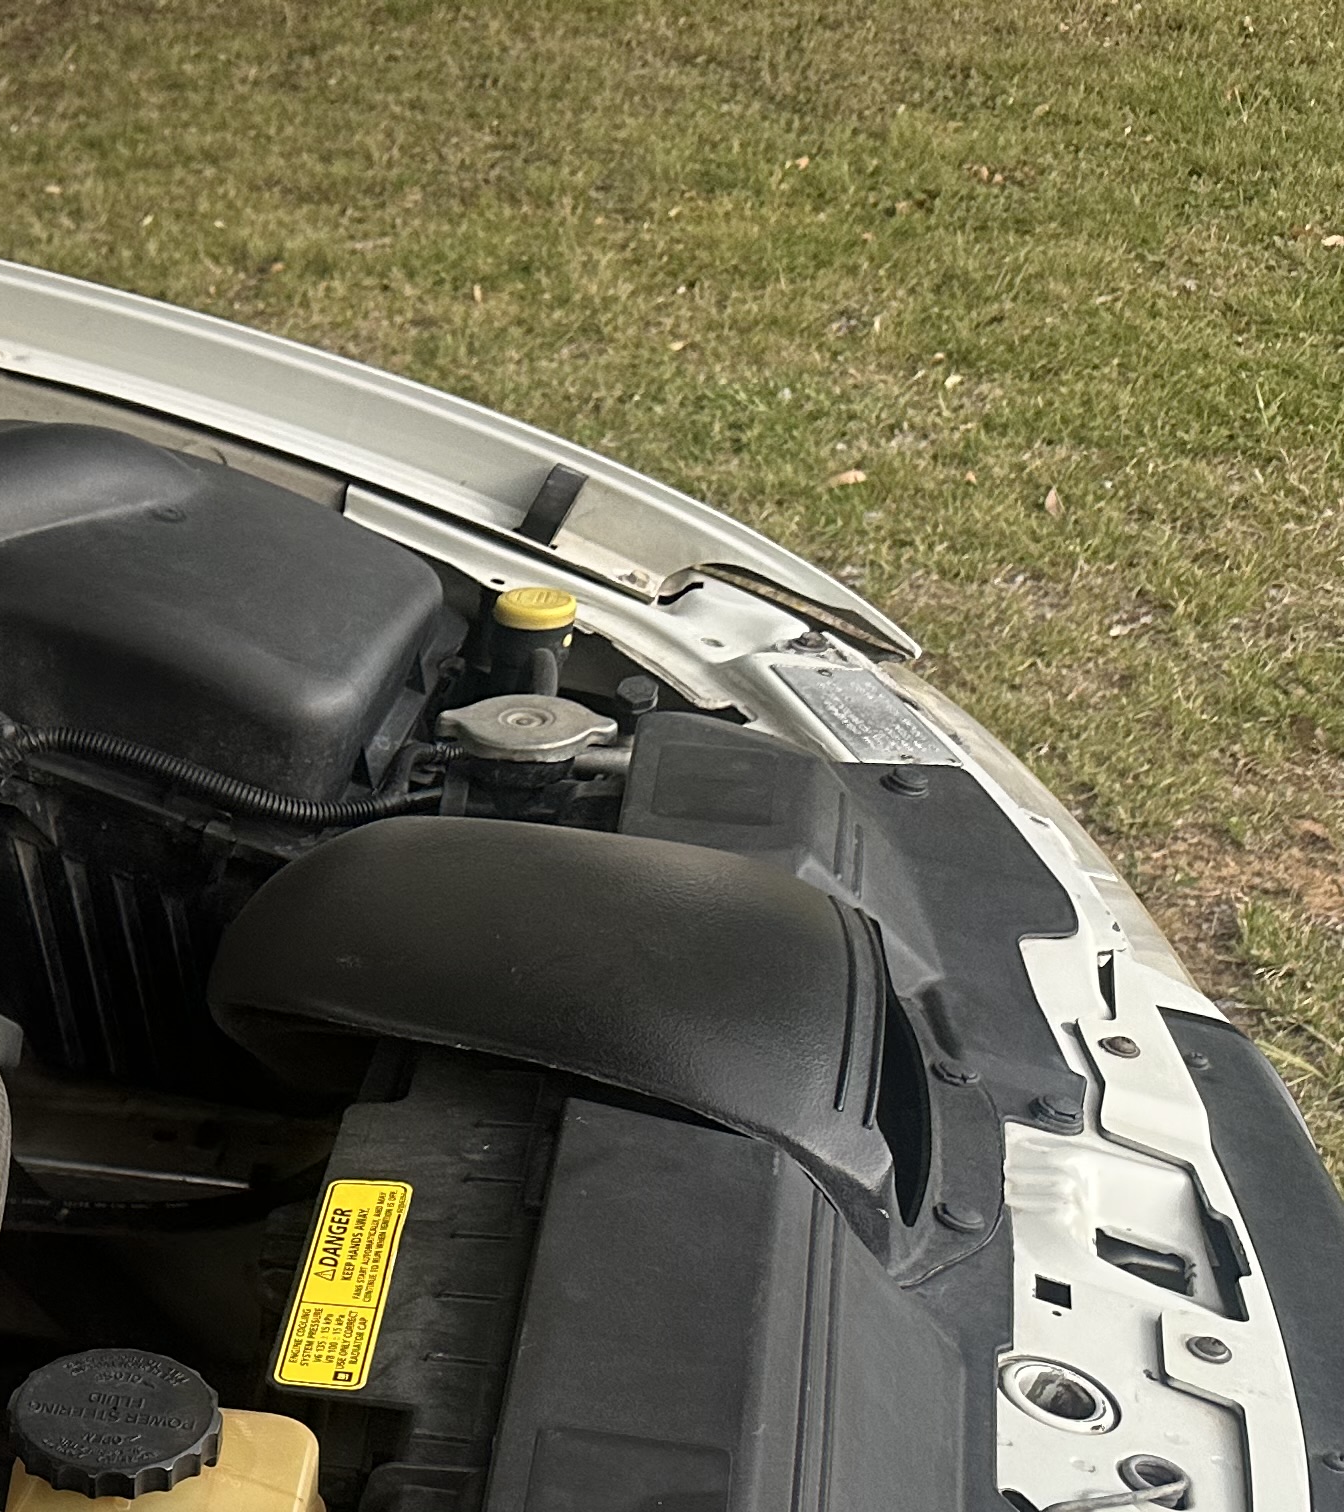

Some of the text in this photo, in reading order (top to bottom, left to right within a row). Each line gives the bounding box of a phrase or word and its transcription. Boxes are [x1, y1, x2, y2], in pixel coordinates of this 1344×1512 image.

[318, 1208, 351, 1267] DANGER
[347, 1232, 363, 1260] HANDS
[340, 1261, 355, 1281] KEEP
[287, 1308, 311, 1363] ENGINE COOLING
[299, 1307, 323, 1366] SYSTEM PRESSURE
[319, 1325, 331, 1333] 15
[331, 1326, 342, 1335] 15
[335, 1310, 358, 1369] USE ONLY CORRECT
[348, 1316, 368, 1365] RADIATOR CAP
[312, 1353, 323, 1362] V6
[315, 1340, 327, 1352] 135
[326, 1341, 338, 1353] 100
[87, 1389, 145, 1411] FLUID
[27, 1396, 195, 1434] POWER STEERING
